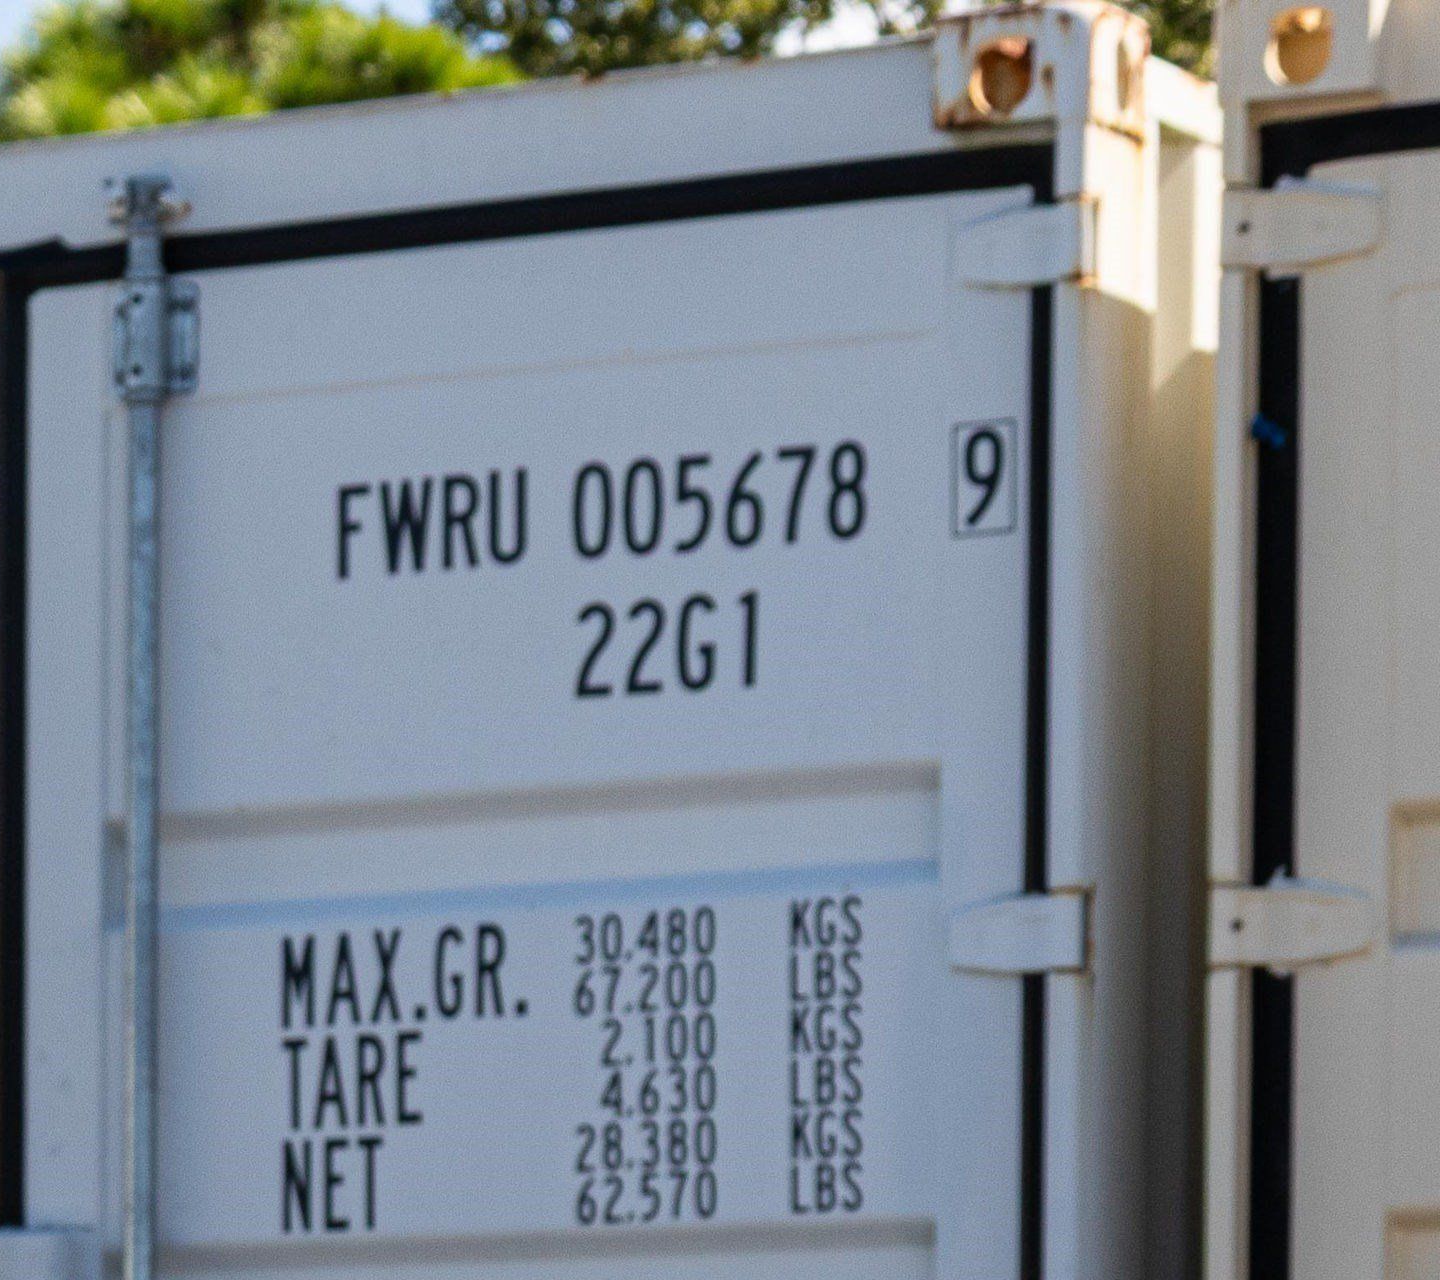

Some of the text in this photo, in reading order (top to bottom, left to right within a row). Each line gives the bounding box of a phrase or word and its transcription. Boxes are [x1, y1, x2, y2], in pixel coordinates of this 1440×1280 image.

[335, 424, 1005, 581] FWRU 005678 9
[573, 589, 760, 700] 22G1
[574, 906, 716, 964] 30.480
[789, 897, 862, 948] KGS
[573, 951, 862, 1017] 67.200 LBS
[280, 1003, 862, 1131] TARE 2.100 KGS
[600, 1055, 862, 1117] 4.630 LBS
[281, 1108, 862, 1234] NET 28.380 KGS
[576, 1160, 862, 1224] 62.570 LBS
